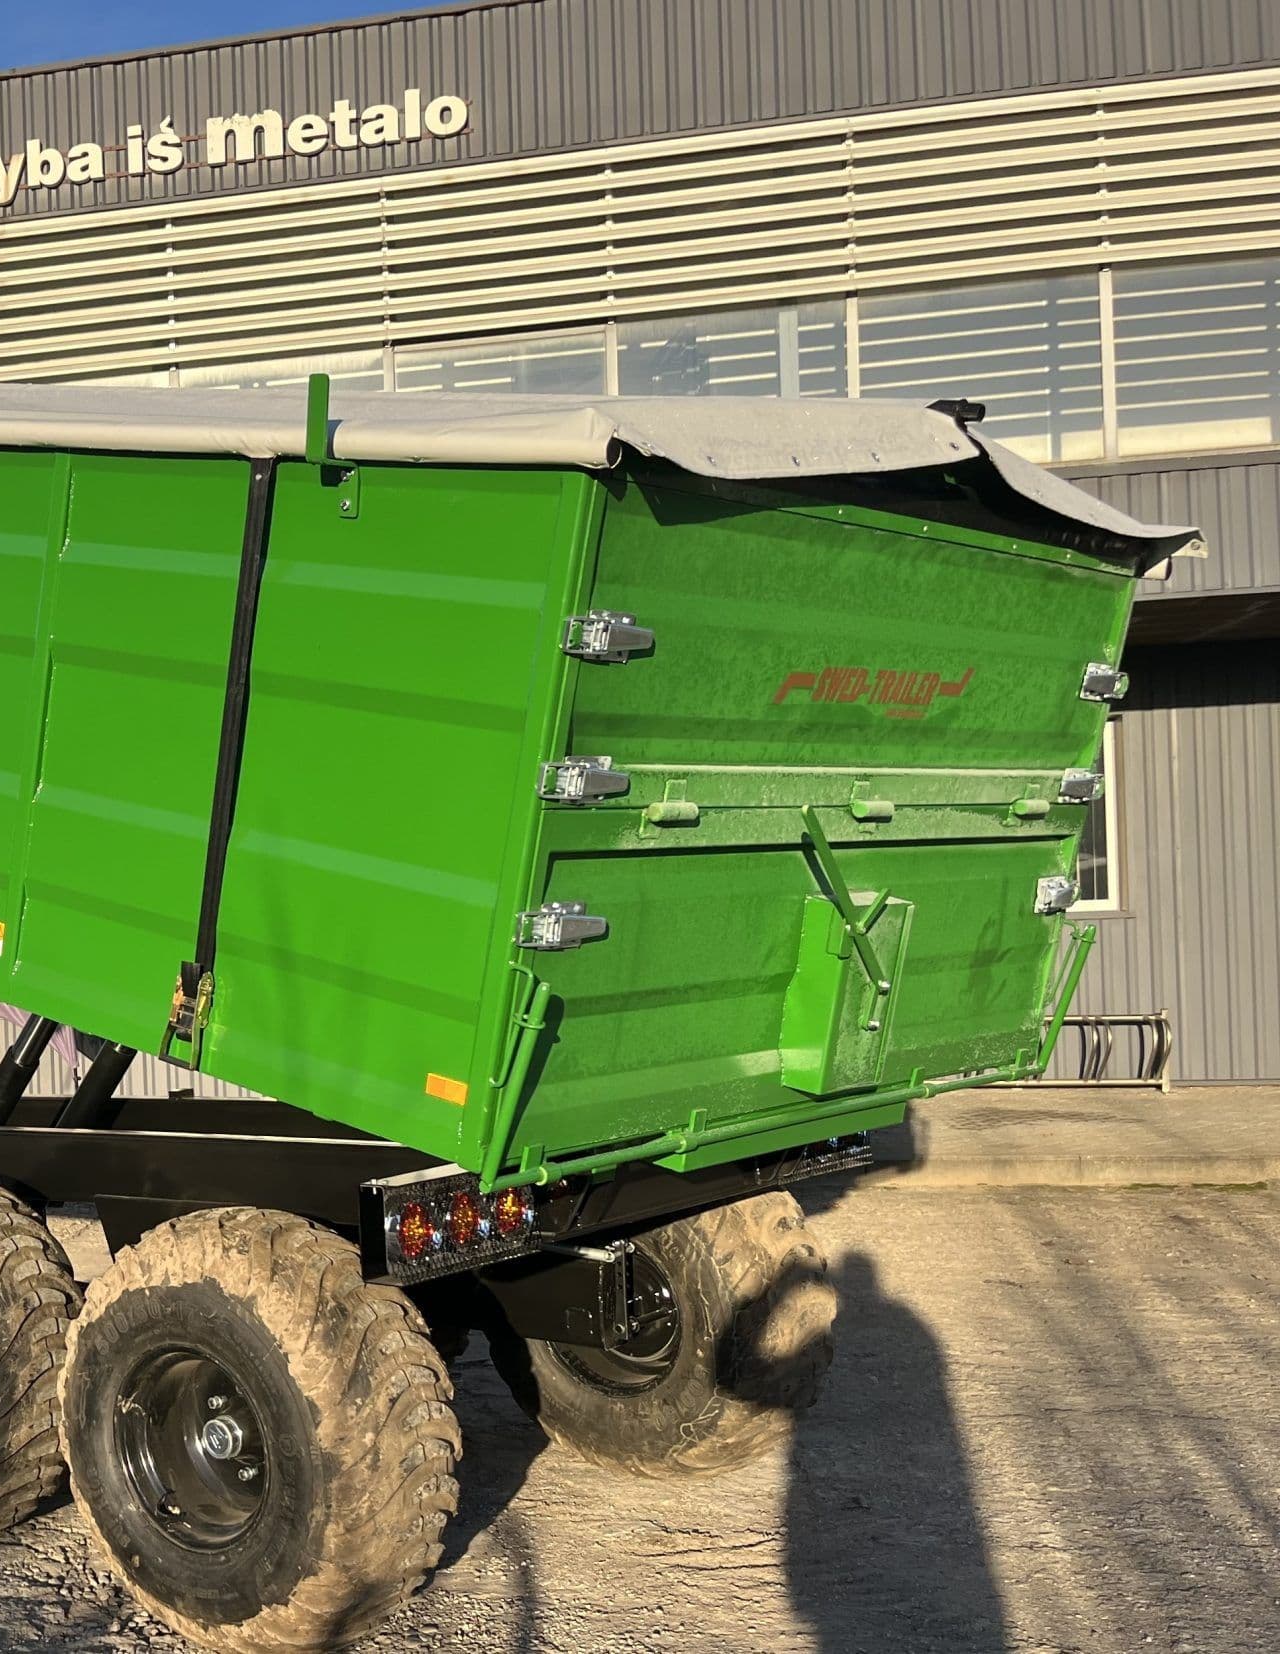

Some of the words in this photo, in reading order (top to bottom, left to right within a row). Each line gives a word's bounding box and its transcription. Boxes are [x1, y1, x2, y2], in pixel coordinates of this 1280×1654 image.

[127, 114, 184, 176] iś
[206, 88, 469, 168] metalo
[811, 667, 941, 705] SWED-TRAILER
